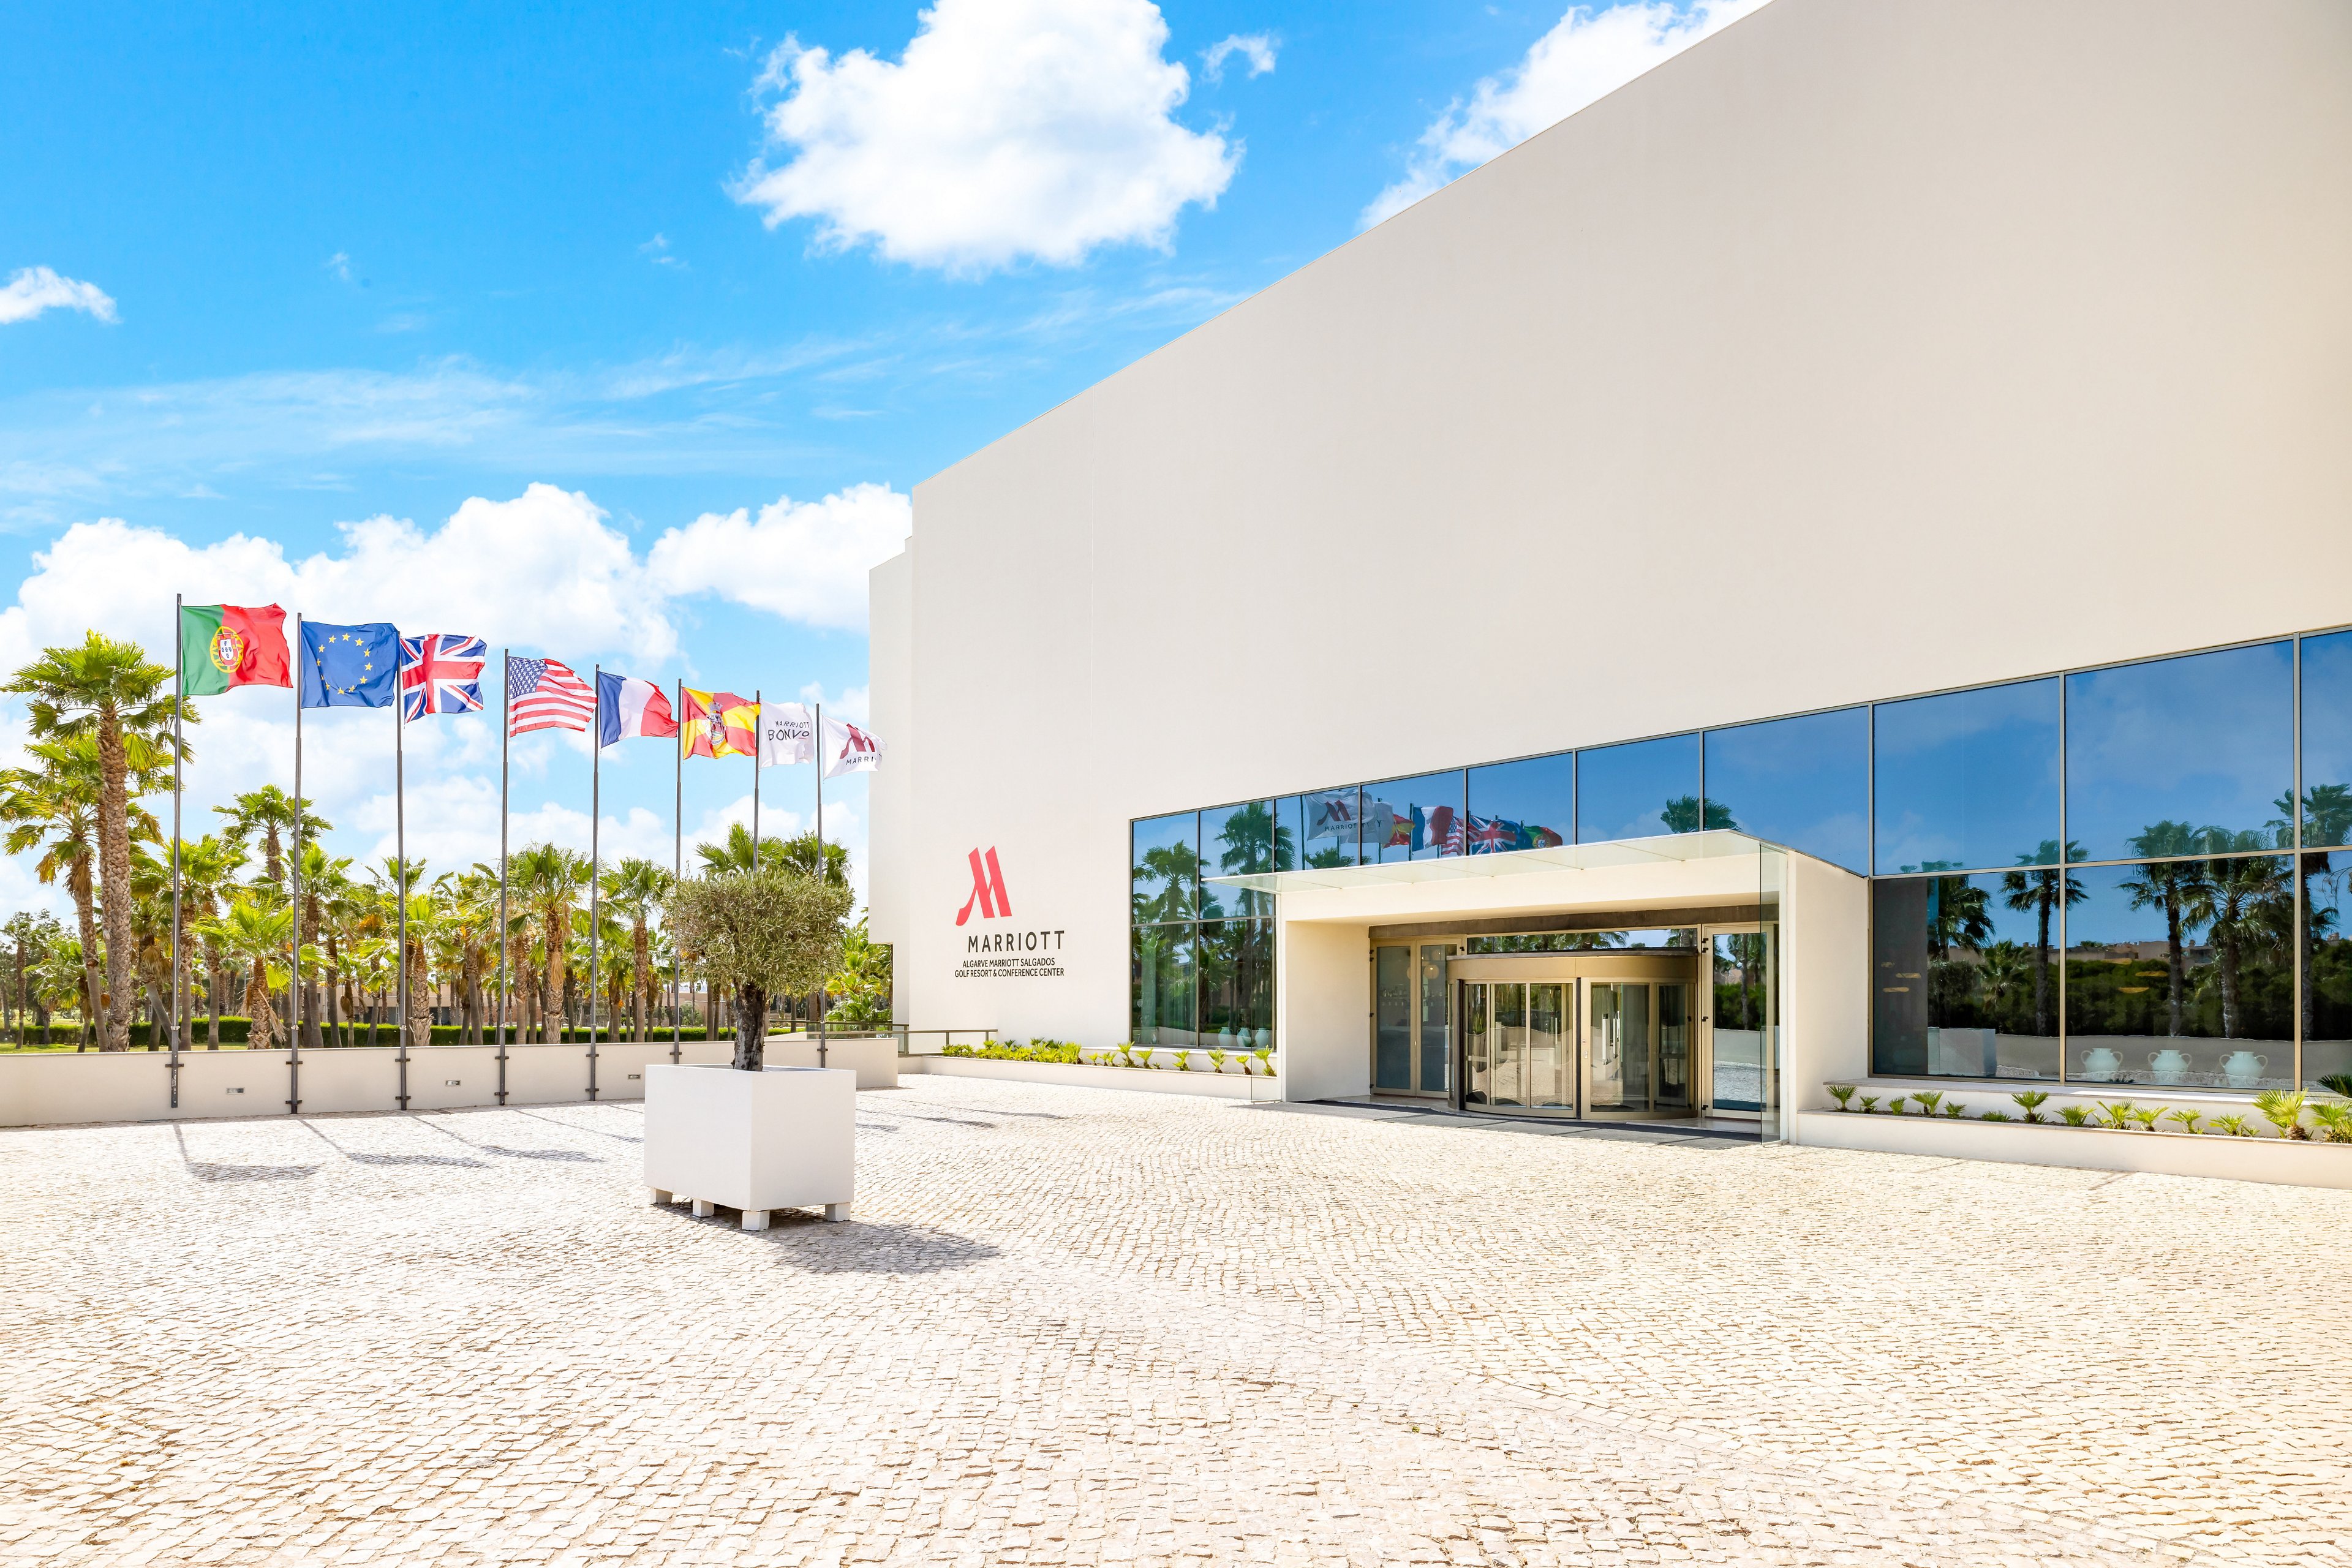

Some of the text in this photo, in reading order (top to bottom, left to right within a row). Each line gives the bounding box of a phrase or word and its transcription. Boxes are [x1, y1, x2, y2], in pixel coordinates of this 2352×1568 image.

[768, 729, 810, 741] BONVO
[846, 753, 882, 765] MARRI
[968, 930, 1065, 953] MARRIOTT
[989, 959, 1020, 967] MARRIOTT
[1020, 958, 1055, 967] SALGADOS
[998, 968, 1038, 977] CONFERENCE
[1039, 968, 1065, 976] CENTER
